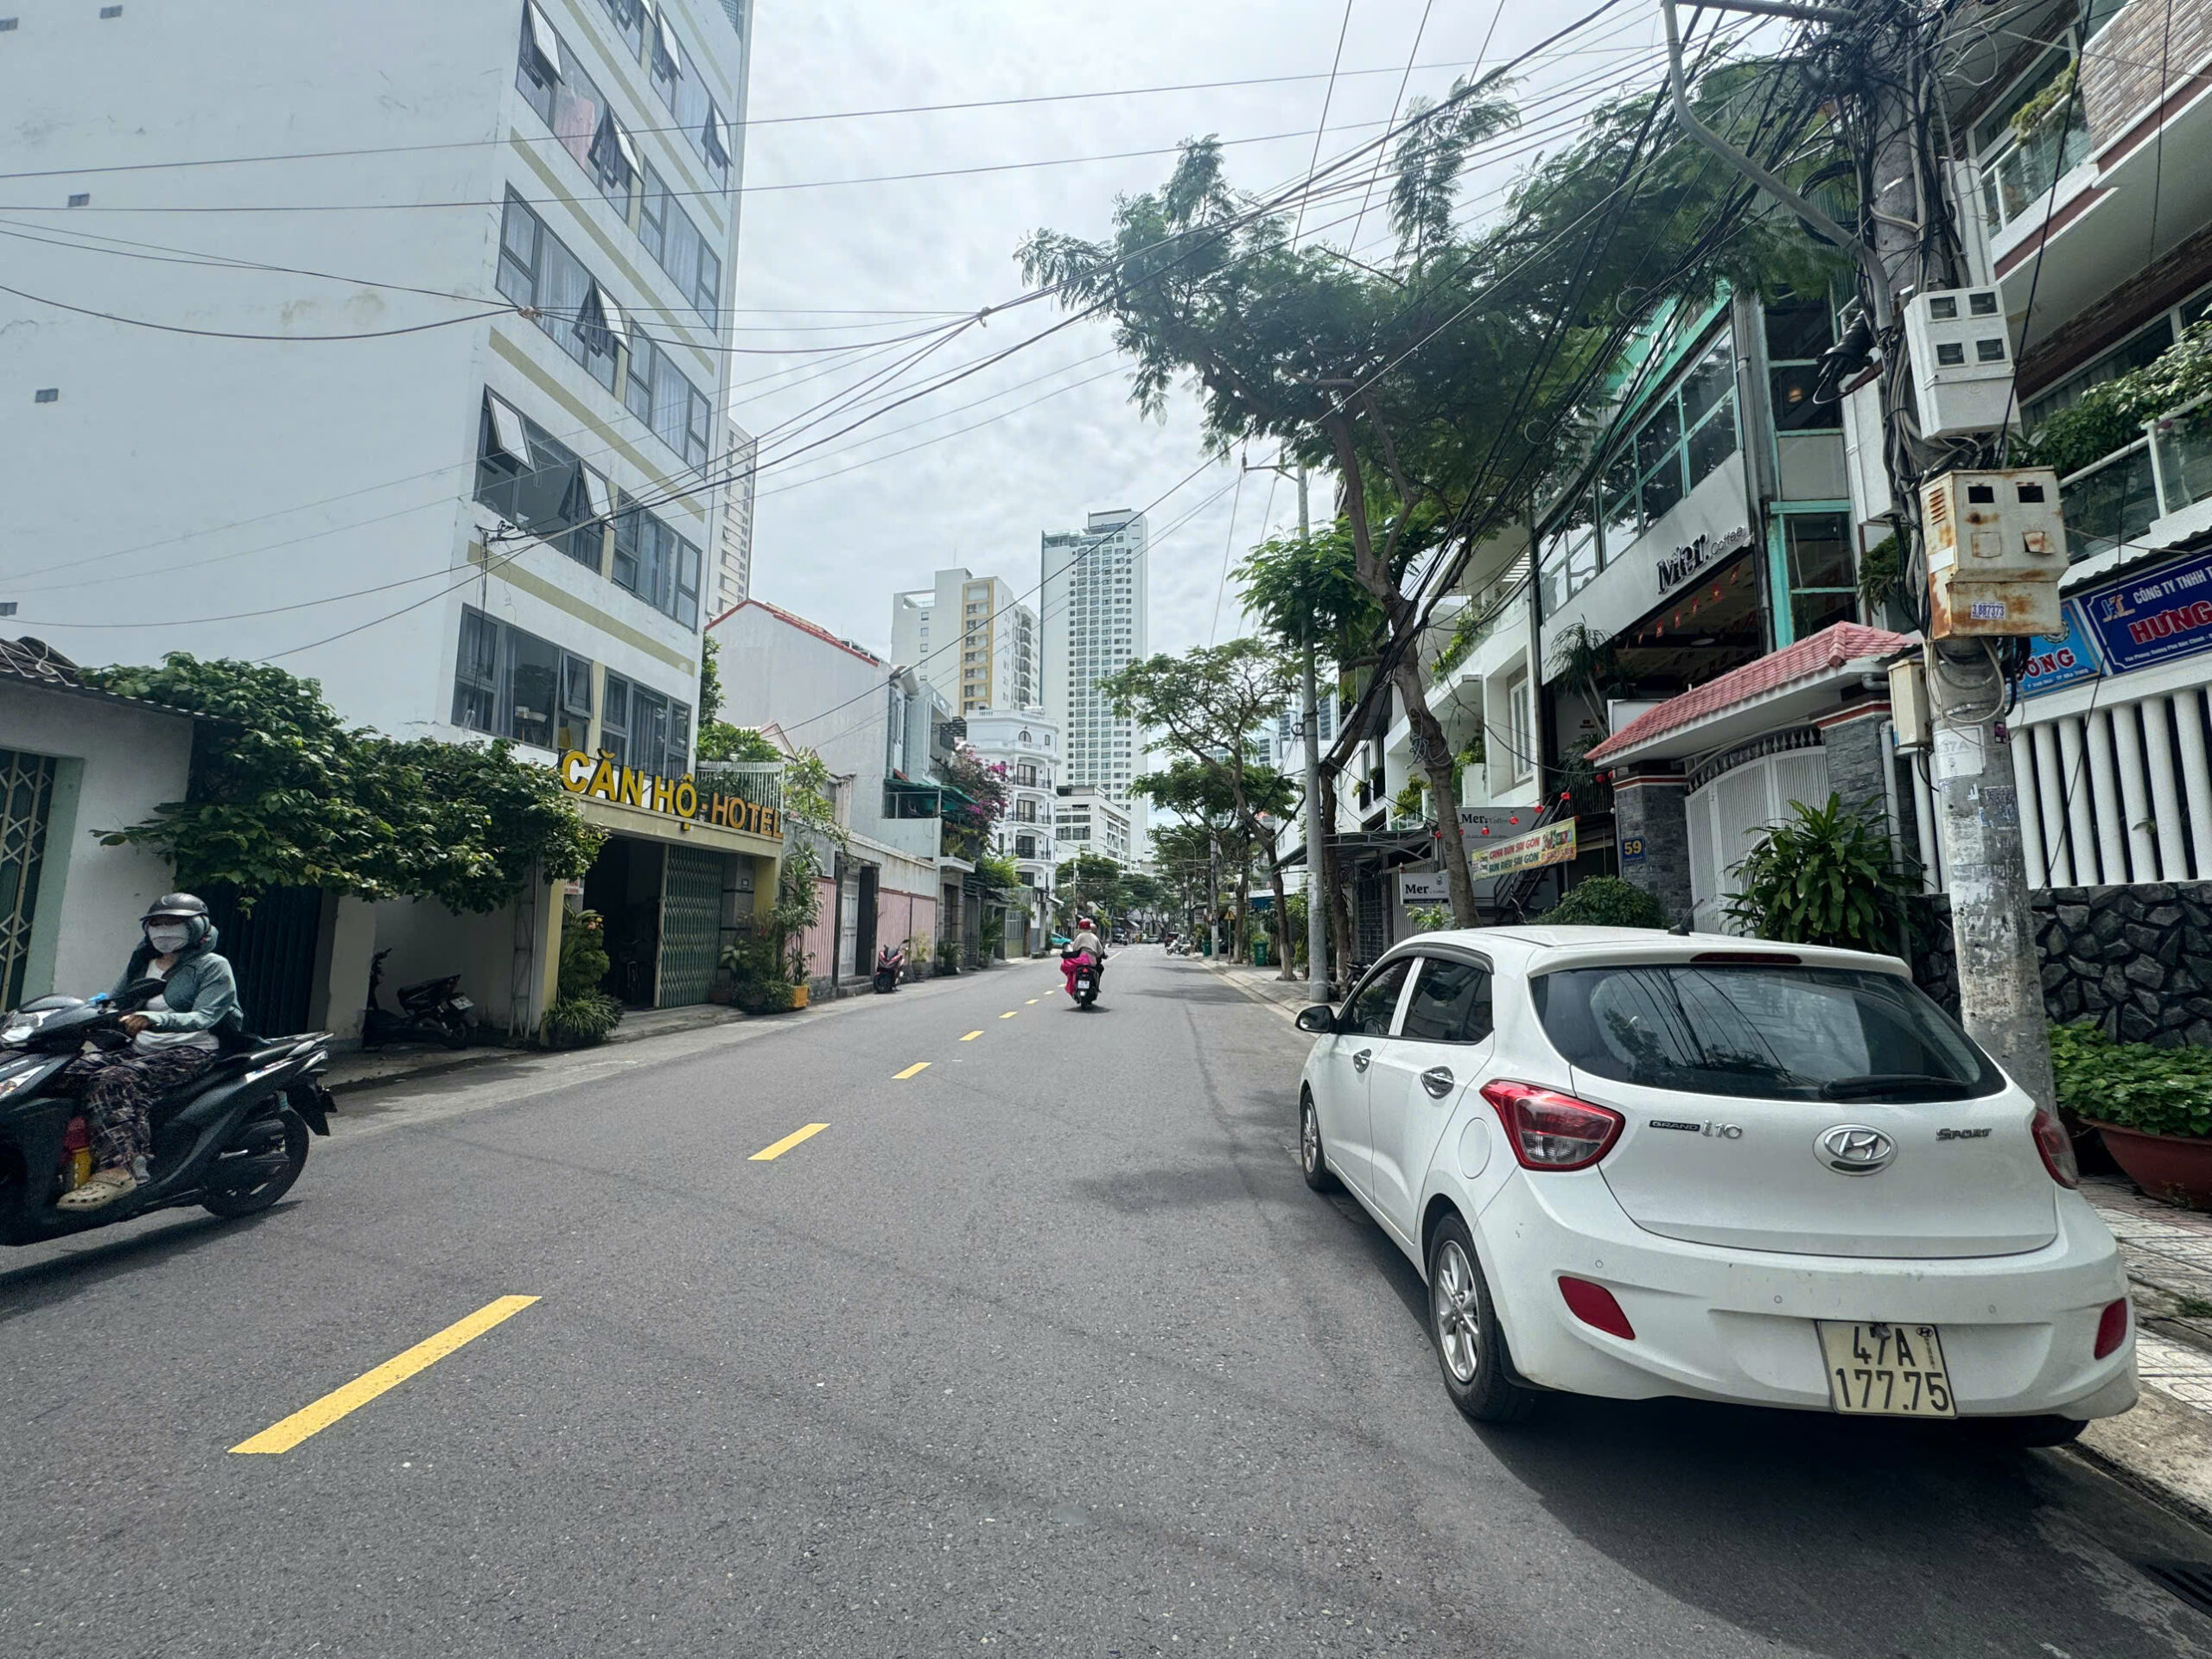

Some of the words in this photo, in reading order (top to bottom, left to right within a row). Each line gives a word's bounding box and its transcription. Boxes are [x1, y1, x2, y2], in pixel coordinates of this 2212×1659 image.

[2133, 585, 2164, 604] CÔNG
[2161, 580, 2177, 594] TY
[2175, 569, 2208, 589] TNHH
[562, 748, 645, 807] CĂN
[652, 772, 697, 830] HỘ
[711, 792, 784, 840] HOTEL
[1624, 840, 1642, 855] 59
[1651, 1121, 1700, 1131] GRAND
[1702, 1119, 1743, 1139] i10
[1853, 1325, 1916, 1367] 47A
[1835, 1368, 1949, 1412] 177.75
